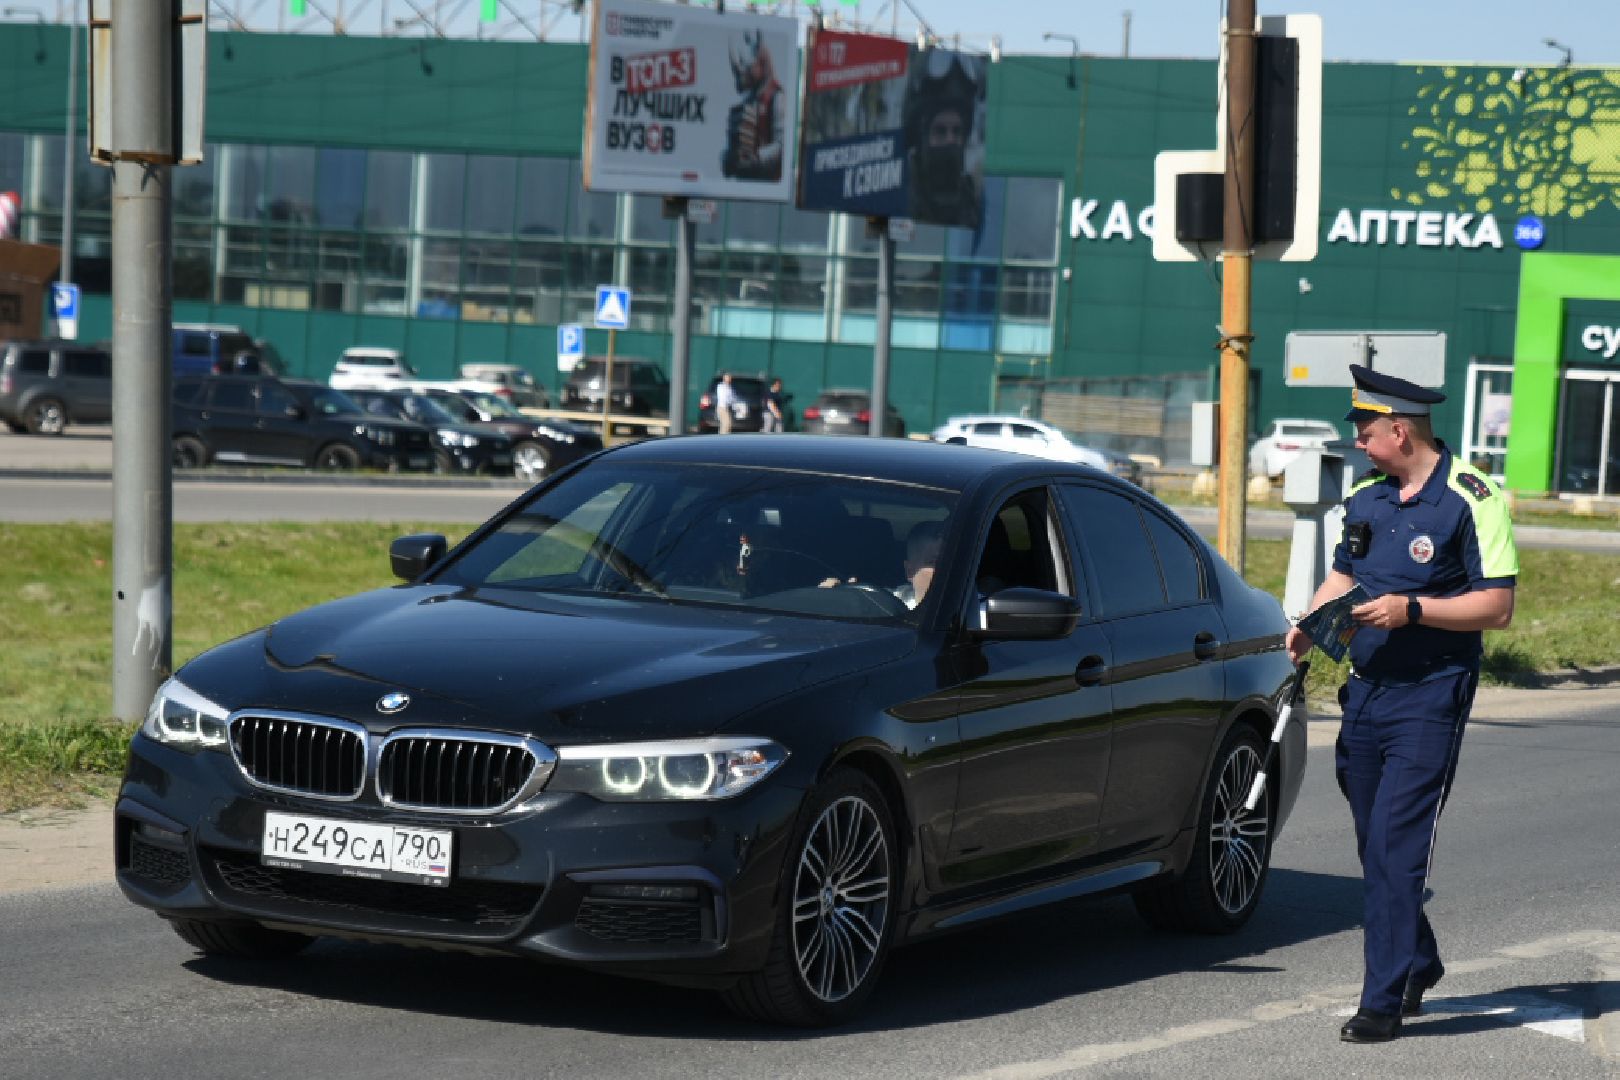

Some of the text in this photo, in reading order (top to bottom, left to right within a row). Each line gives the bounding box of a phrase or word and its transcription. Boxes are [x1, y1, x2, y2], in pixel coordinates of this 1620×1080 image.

[611, 51, 691, 90] В ТОП-3
[614, 88, 707, 122] ЛУЧШИХ
[607, 121, 676, 153] ВУЗОВ
[1326, 207, 1504, 248] АПТЕКА
[274, 822, 441, 863] Н249СА 790
[405, 858, 428, 870] RUS
